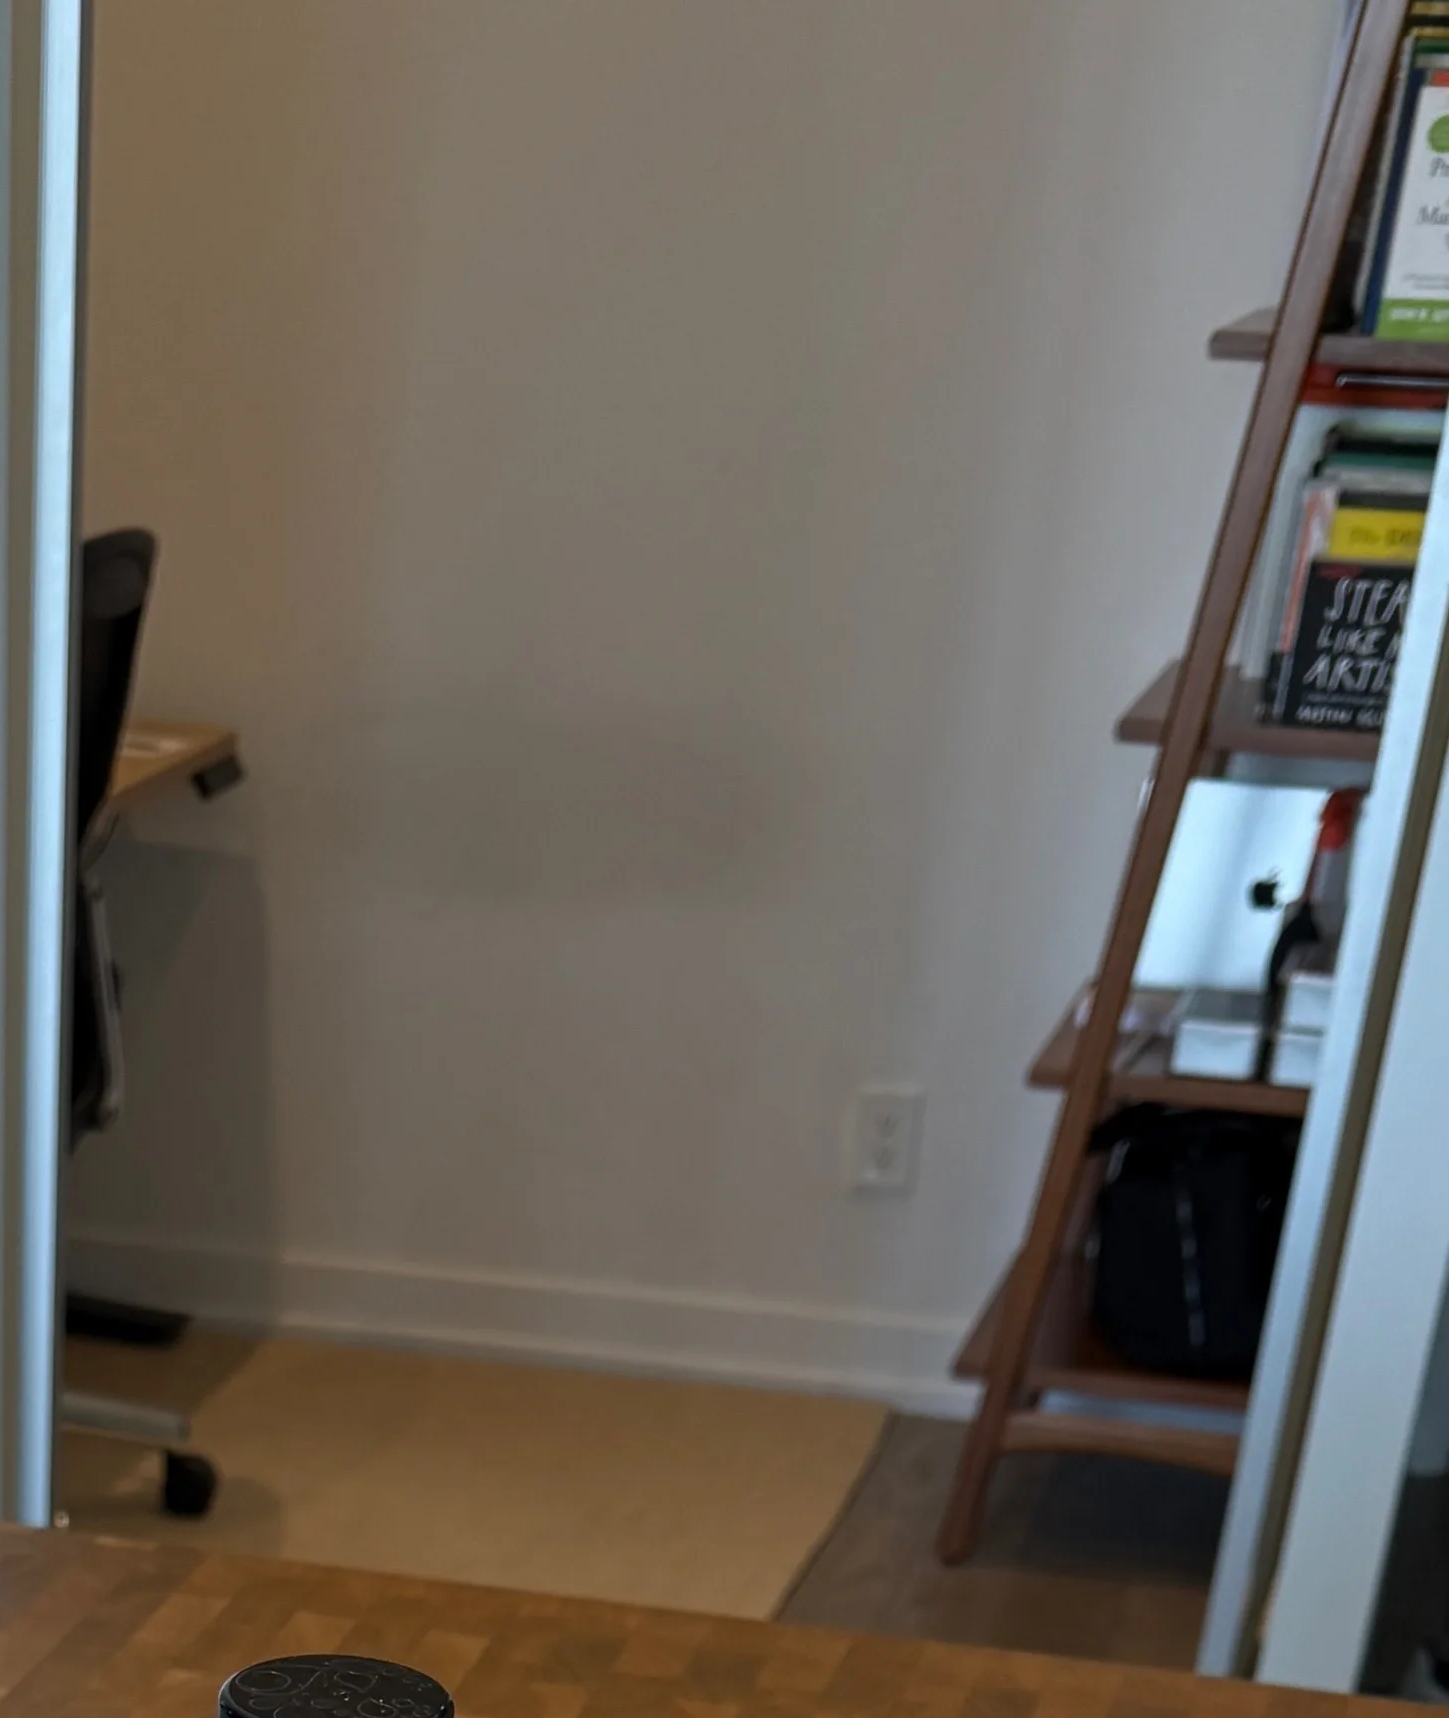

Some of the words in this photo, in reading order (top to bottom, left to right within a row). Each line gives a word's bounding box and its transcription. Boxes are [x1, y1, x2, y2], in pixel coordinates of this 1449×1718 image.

[1325, 576, 1409, 626] STEA
[1317, 625, 1386, 656] LIKE
[1304, 654, 1390, 693] ARTI
